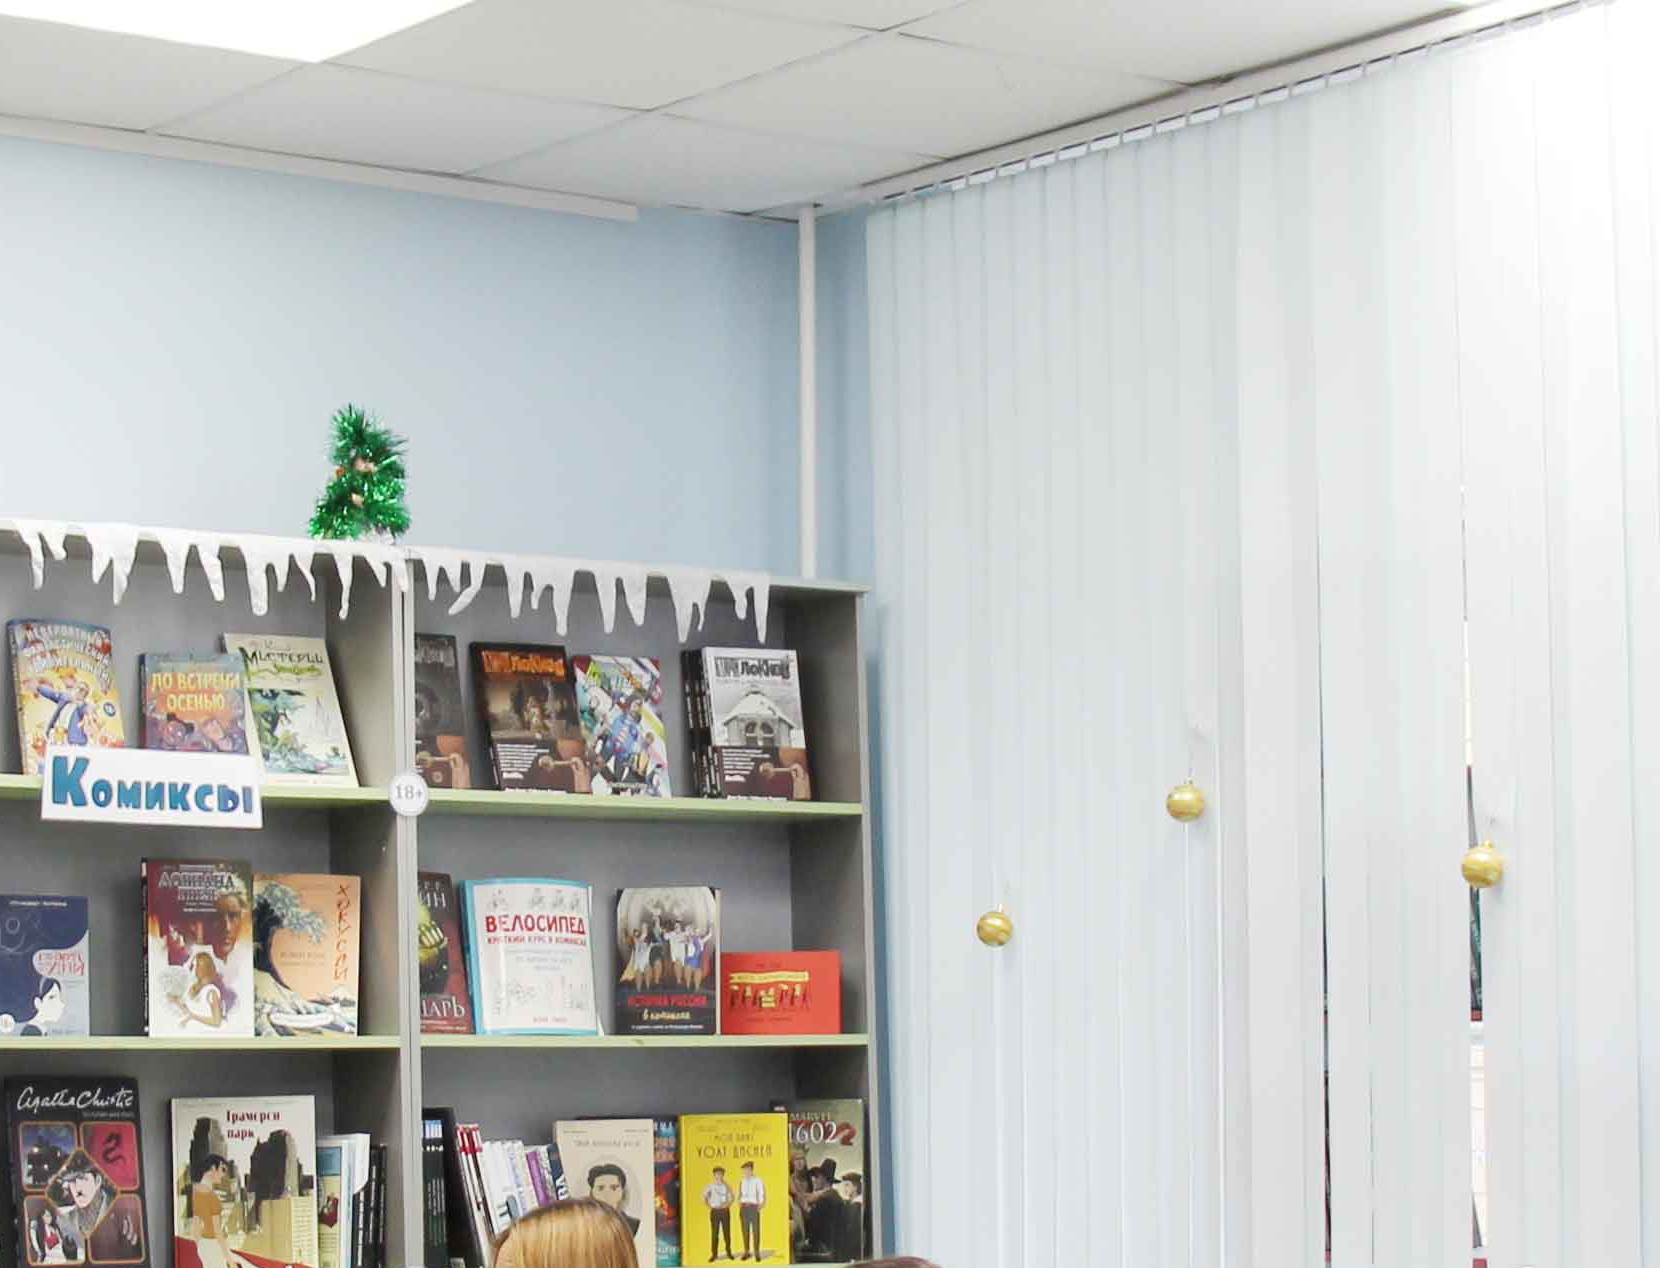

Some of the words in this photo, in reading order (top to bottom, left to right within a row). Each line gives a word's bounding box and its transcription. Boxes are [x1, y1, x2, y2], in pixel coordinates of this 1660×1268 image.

[152, 673, 172, 691] ДО
[167, 693, 225, 711] ОСЕНЬЮ
[52, 755, 253, 814] Комиксы
[395, 784, 424, 799] 18+
[485, 914, 586, 935] ВЕЛОСИПЕД
[17, 1086, 76, 1114] Agatha
[76, 1087, 133, 1109] Christie
[789, 1121, 837, 1144] 1602
